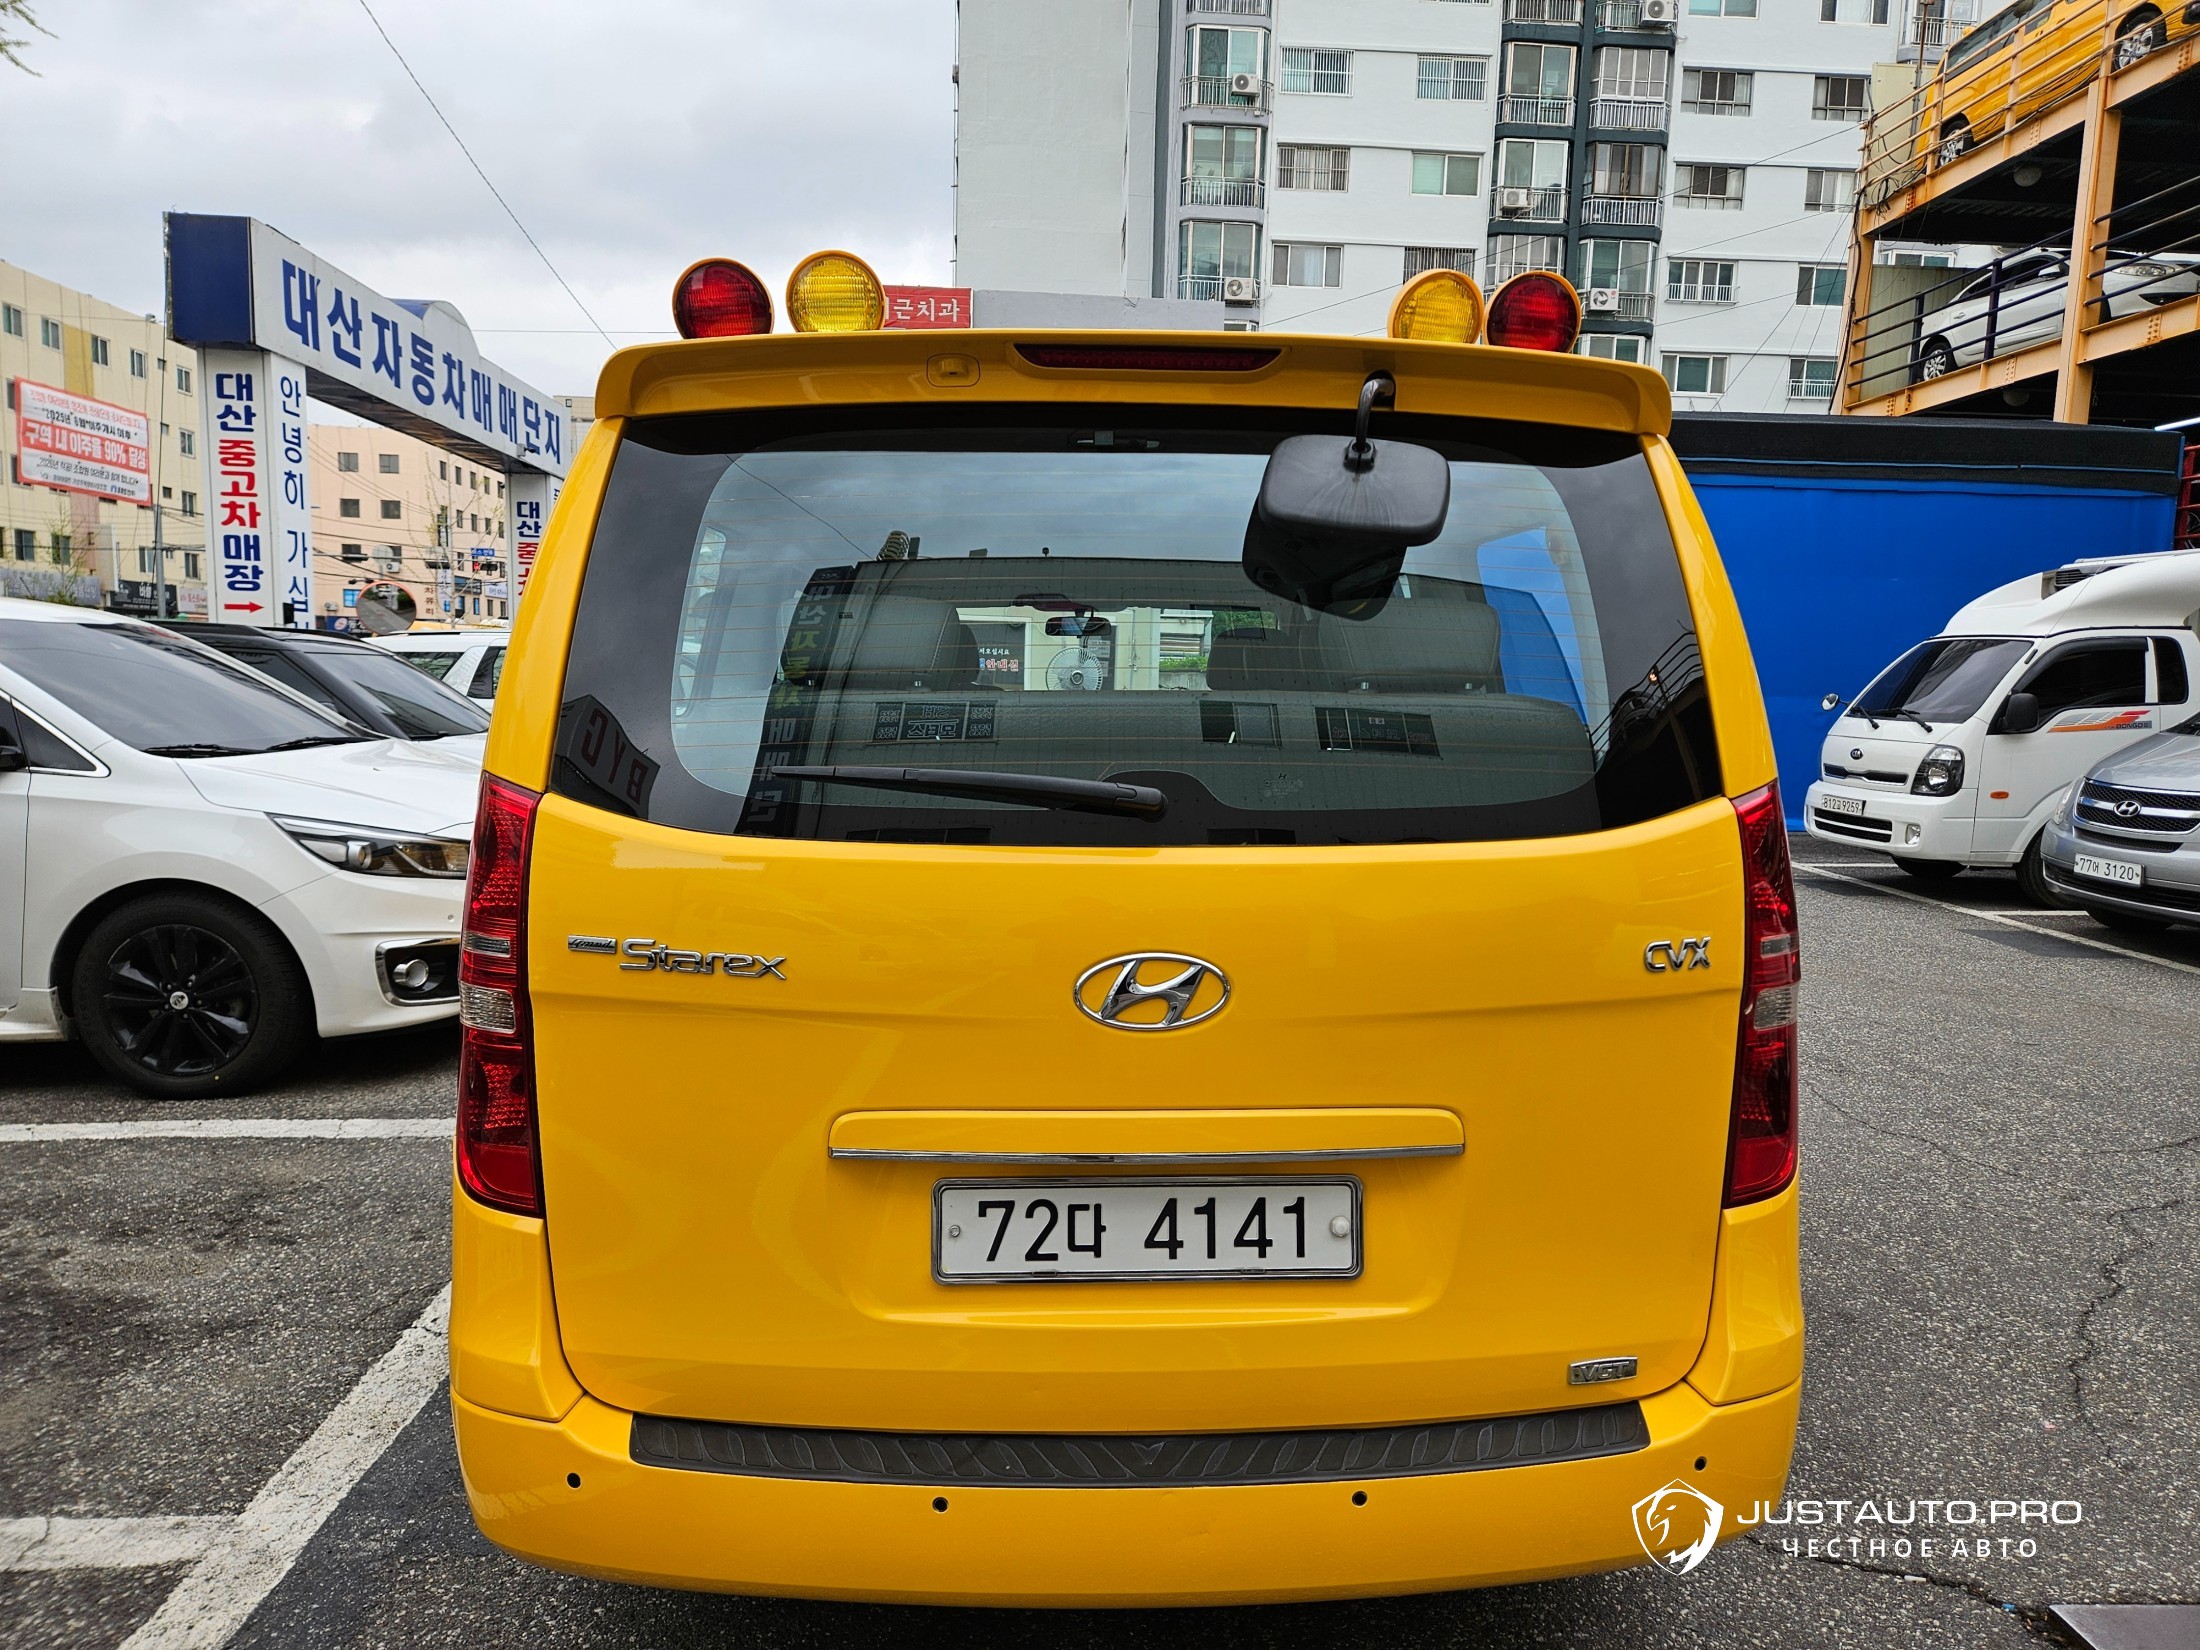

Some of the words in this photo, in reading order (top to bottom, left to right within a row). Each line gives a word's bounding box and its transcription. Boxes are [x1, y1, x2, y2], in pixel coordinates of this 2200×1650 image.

[885, 297, 960, 322] 근치과
[282, 259, 560, 465] 대산자동차매매단지
[25, 422, 52, 448] 구역
[55, 428, 68, 452] 내
[104, 440, 126, 465] 90%
[280, 376, 305, 510] 안녕히
[516, 501, 542, 596] 대산중
[287, 530, 310, 629] 가십
[2104, 862, 2134, 881] 3120
[620, 938, 787, 980] Starex
[1645, 937, 1712, 972] CVX
[978, 1197, 1107, 1262] 72다
[1144, 1196, 1306, 1260] 4141
[1580, 1361, 1630, 1380] VGT
